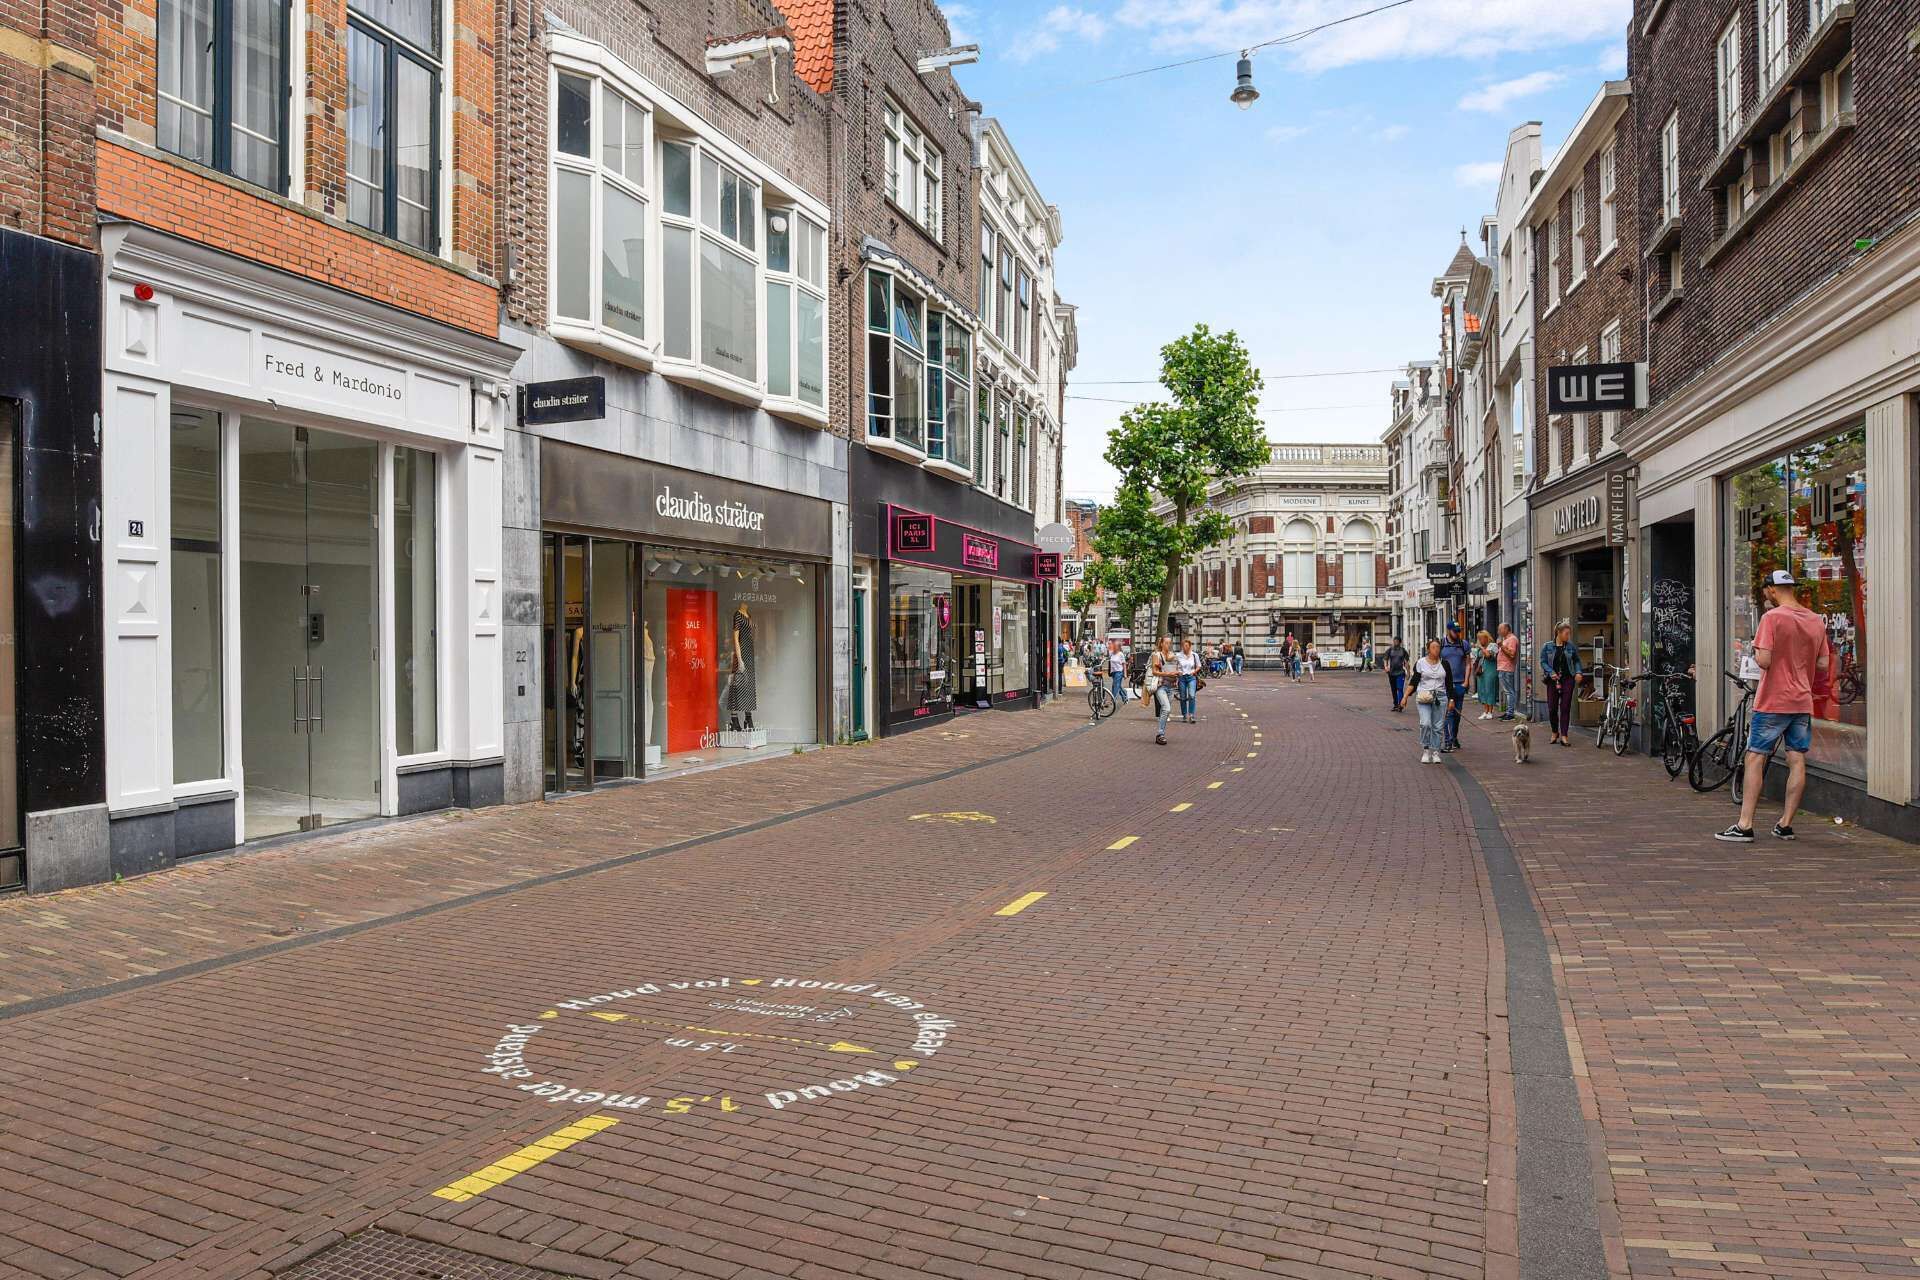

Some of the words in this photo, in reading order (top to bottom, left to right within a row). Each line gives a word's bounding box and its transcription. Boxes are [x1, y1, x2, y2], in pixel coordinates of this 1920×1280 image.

[265, 354, 305, 378] Fred
[314, 366, 323, 382] &
[333, 370, 402, 400] Mardonio
[1559, 372, 1625, 403] WE
[533, 395, 560, 408] claudia
[561, 394, 589, 406] sträter
[656, 486, 713, 524] claudia
[715, 500, 765, 531] sträter
[1553, 495, 1598, 537] MANFIELD
[1611, 474, 1624, 543] MANFIELD
[131, 522, 142, 536] 24
[1064, 563, 1083, 574] Etos
[568, 607, 585, 615] SAL
[686, 620, 701, 629] SALE
[516, 651, 527, 662] 22
[555, 983, 662, 1010] Houd
[770, 978, 877, 992] Houd
[871, 990, 924, 1010] van
[912, 1012, 957, 1056] elkaar
[481, 1024, 544, 1080] afstand
[517, 1081, 651, 1109] meter
[764, 1070, 899, 1110] Houd
[663, 1096, 742, 1114] 1,5
